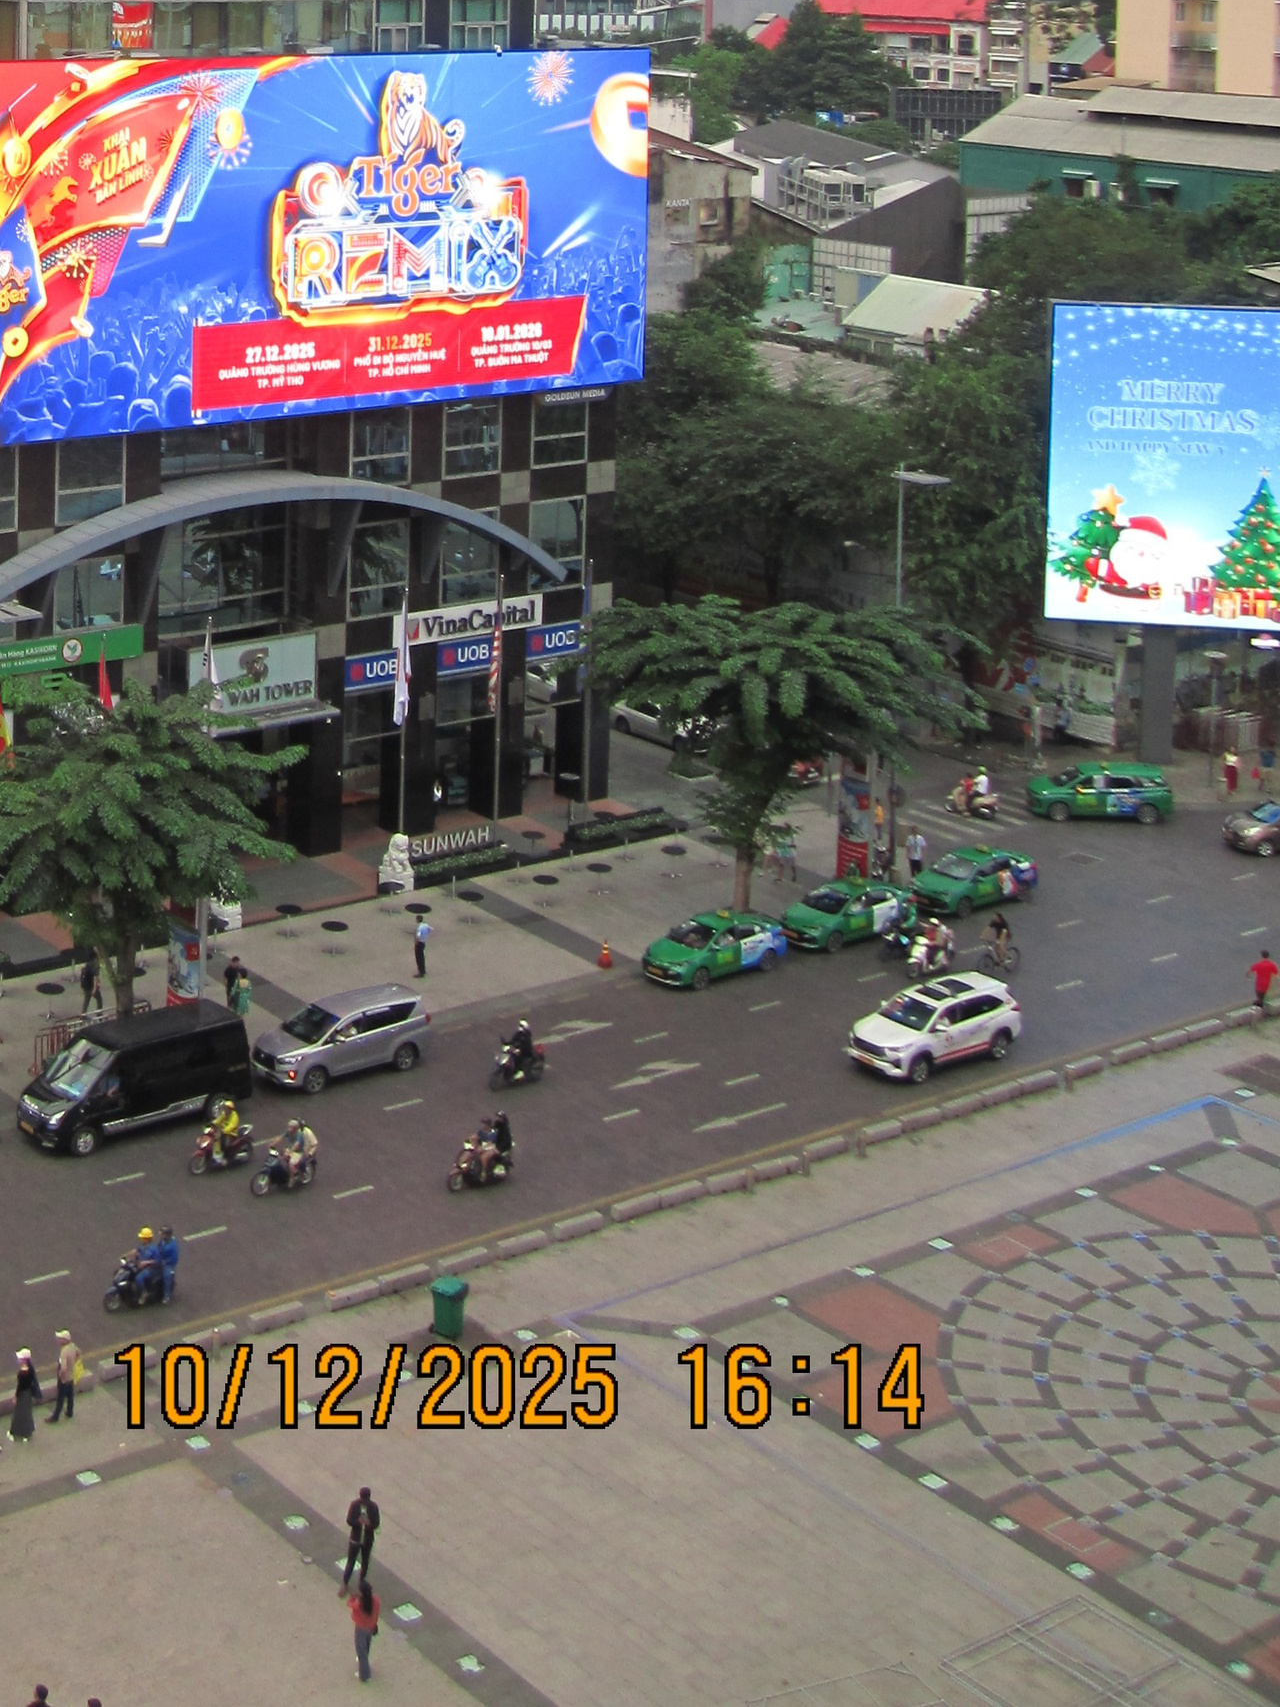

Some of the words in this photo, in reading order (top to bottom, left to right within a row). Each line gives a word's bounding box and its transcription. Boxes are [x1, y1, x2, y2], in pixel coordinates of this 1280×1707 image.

[102, 126, 131, 153] KHAI
[88, 136, 147, 191] XUÂN
[356, 149, 463, 217] Tiger
[293, 221, 521, 299] REMIX
[368, 332, 432, 352] 31.12.2025
[410, 363, 431, 374] MINH
[544, 391, 581, 402] GOLDSUN
[582, 388, 606, 399] MEDIA
[1120, 379, 1224, 404] MERRY
[1086, 405, 1259, 435] CHRISTMAS
[1087, 439, 1116, 451] AND
[1120, 440, 1170, 454] HAPPY
[1176, 442, 1210, 455] NEW
[423, 600, 535, 637] VinaCapital
[545, 630, 577, 648] UOB
[457, 644, 490, 663] UOB
[366, 659, 398, 678] UOB
[264, 680, 313, 701] TOWER
[411, 826, 490, 858] SUNWAH
